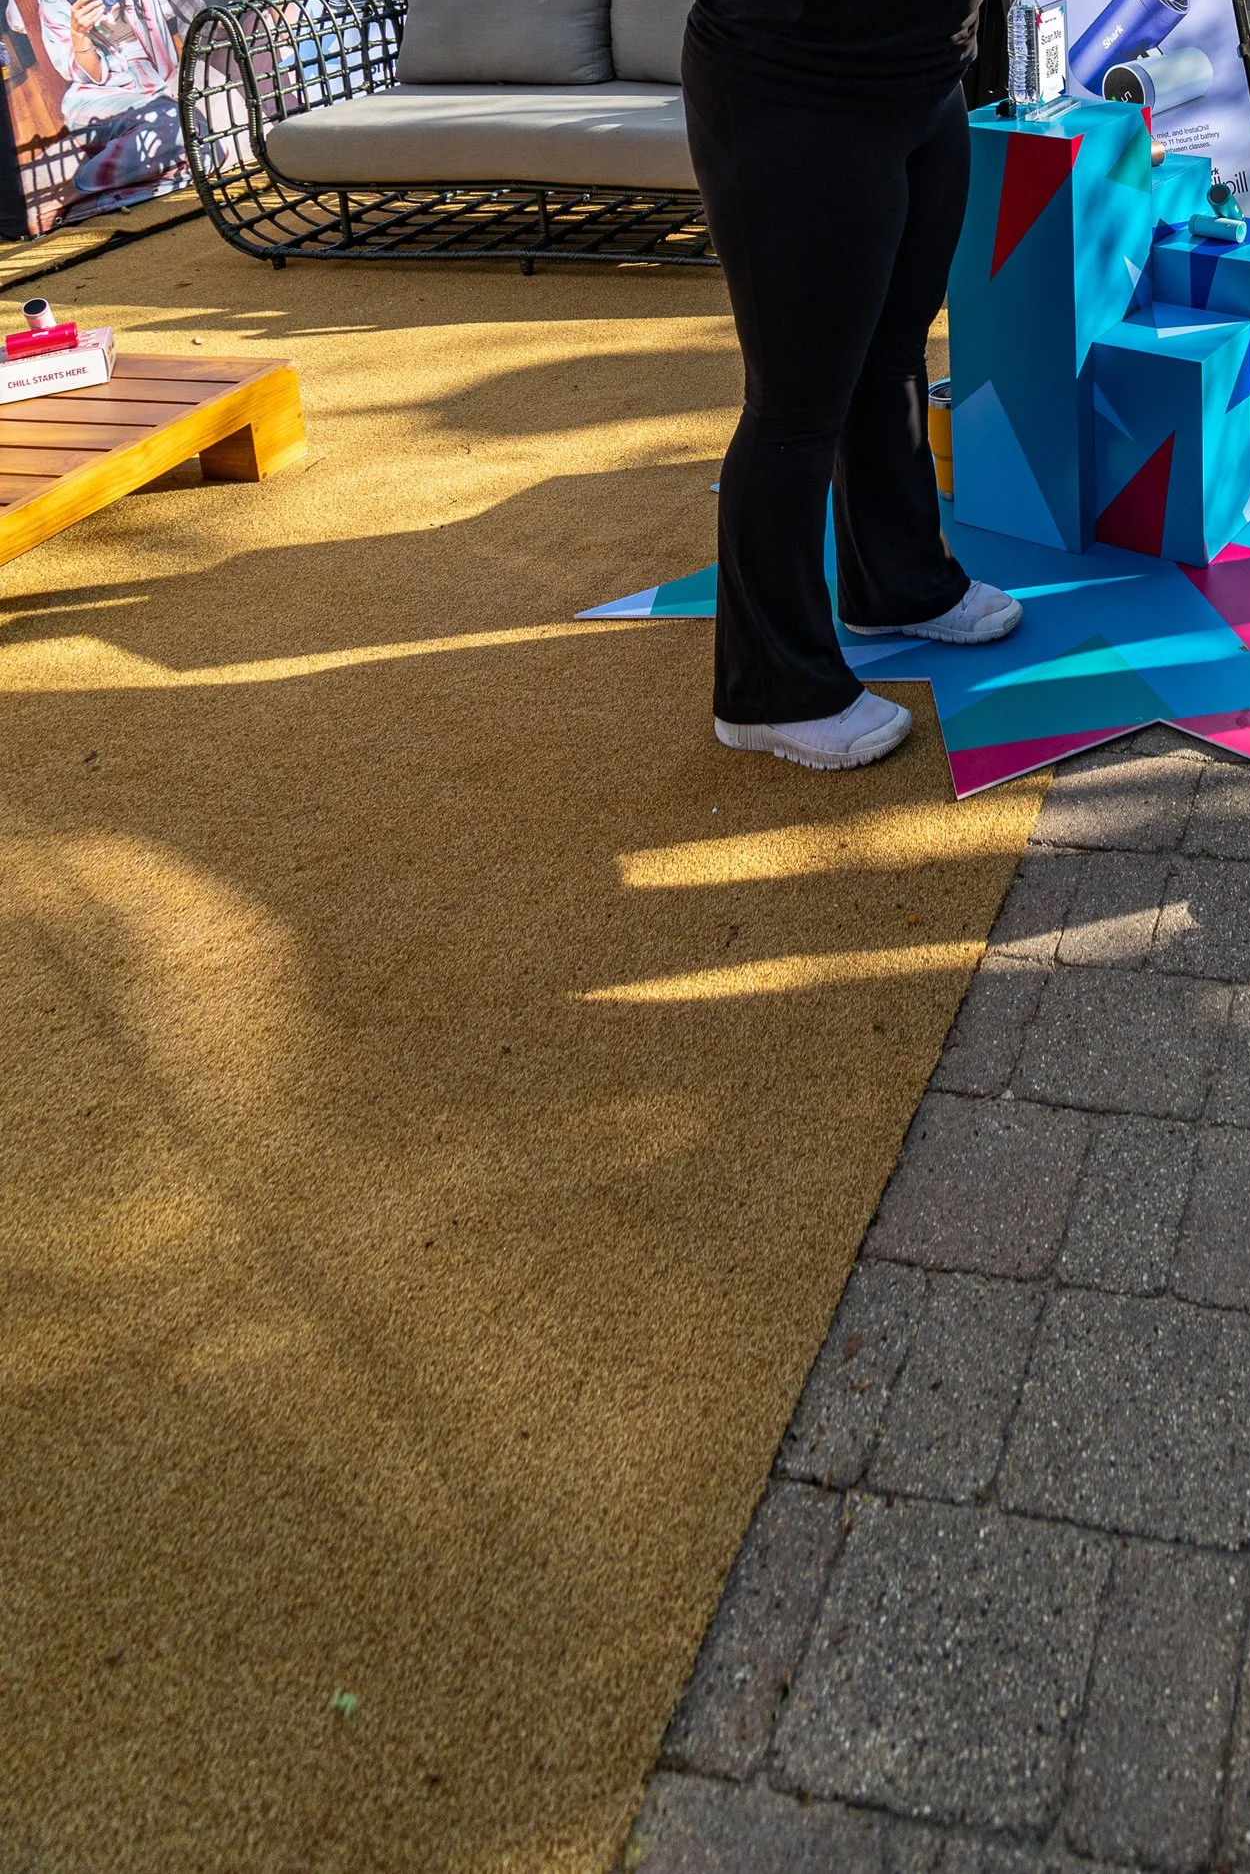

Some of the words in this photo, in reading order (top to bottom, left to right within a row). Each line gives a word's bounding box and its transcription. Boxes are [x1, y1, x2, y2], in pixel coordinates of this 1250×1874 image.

[1041, 33, 1053, 45] Scan
[1102, 24, 1124, 50] Shark
[1171, 129, 1184, 137] and
[1184, 124, 1210, 135] InstaChill
[1176, 135, 1193, 144] hours
[1200, 131, 1220, 140] battery
[1188, 140, 1212, 151] classes.
[7, 379, 32, 390] CHILL
[32, 371, 65, 385] STARTS
